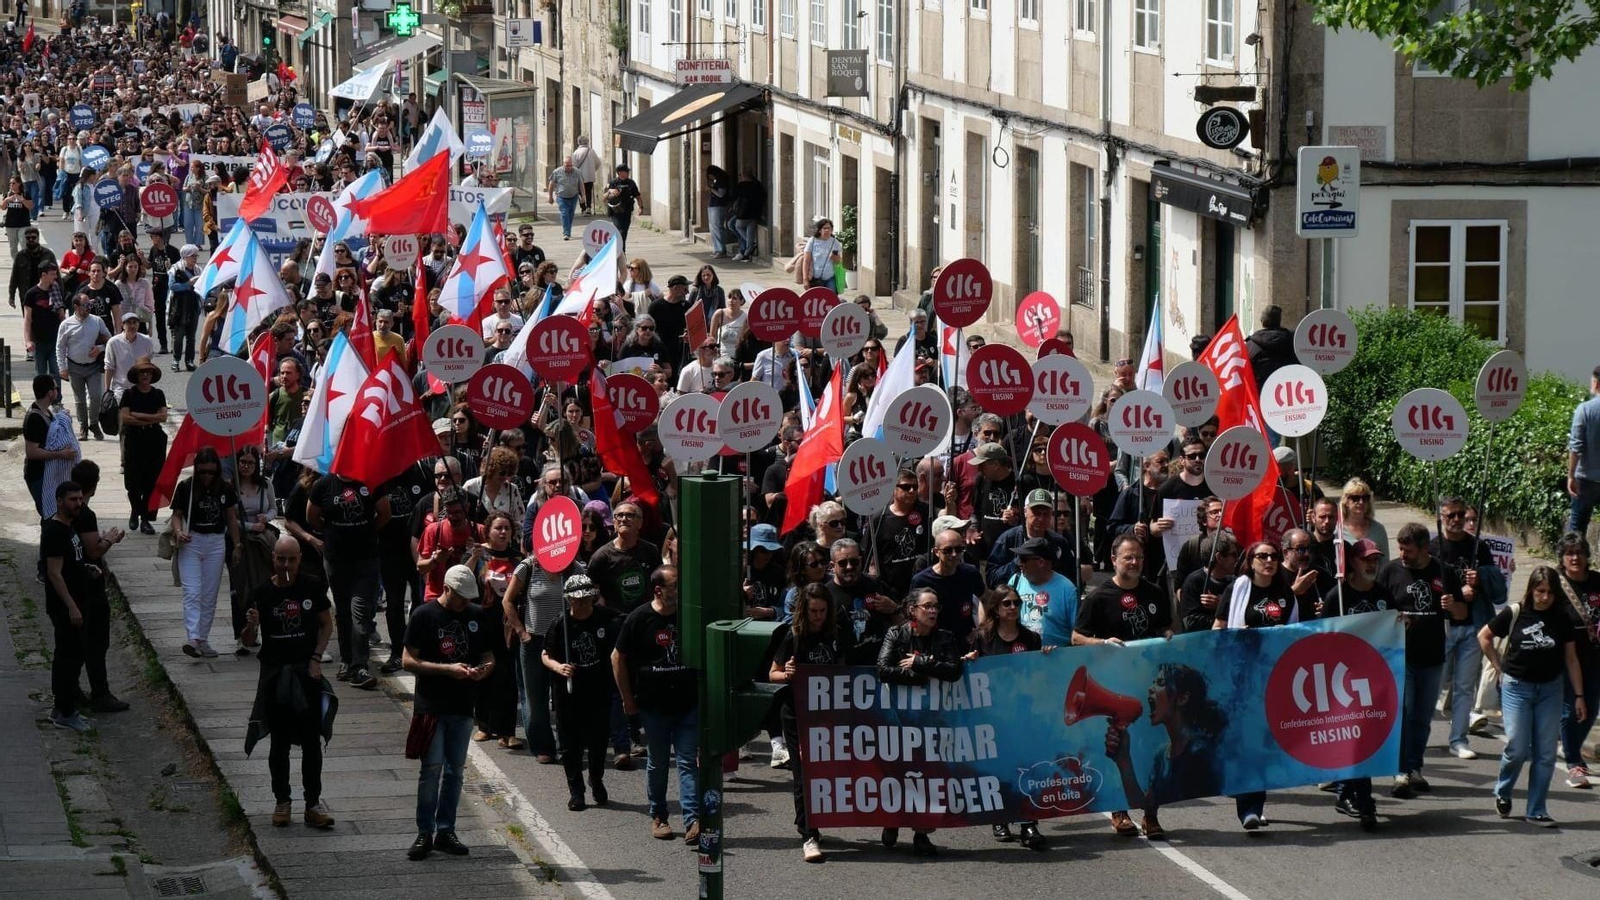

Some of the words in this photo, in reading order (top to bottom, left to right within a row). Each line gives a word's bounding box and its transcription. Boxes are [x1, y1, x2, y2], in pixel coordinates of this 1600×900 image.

[678, 61, 730, 71] CONFITERIA
[831, 56, 863, 64] DENTAL
[831, 70, 861, 78] ROQUE
[74, 118, 94, 126] STEG
[268, 136, 289, 146] STEG
[470, 144, 492, 152] STEG
[88, 156, 108, 168] STEG
[100, 193, 122, 206] STEG
[148, 190, 171, 203] CIG
[313, 202, 333, 224] CIG
[591, 228, 612, 244] CIG
[392, 239, 412, 254] CIG
[946, 274, 982, 299] CIG
[760, 299, 794, 320] CIG
[804, 297, 832, 318] CIG
[952, 306, 972, 314] ENSINO
[766, 324, 785, 332] ENSINO
[832, 315, 861, 336] CIG
[1308, 323, 1346, 348] CIG
[436, 338, 474, 359] CIG
[540, 330, 579, 353] CIG
[444, 364, 465, 372] ENSINO
[548, 360, 570, 368] ENSINO
[1211, 332, 1246, 391] CIG
[1314, 354, 1336, 362] ENSINO
[979, 359, 1022, 387] CIG
[1038, 370, 1080, 396] CIG
[1487, 366, 1518, 392] CIG
[202, 374, 252, 404] CIG
[482, 375, 523, 408] CIG
[992, 393, 1014, 401] ENSINO
[1174, 375, 1209, 400] CIG
[1274, 380, 1315, 408] CIG
[608, 386, 647, 411] CIG
[1046, 402, 1070, 411] ENSINO
[1490, 400, 1508, 408] ENSINO
[216, 410, 242, 420] ENSINO
[486, 406, 508, 418] ENSINO
[730, 396, 770, 424] CIG
[900, 400, 938, 432] CIG
[1122, 405, 1164, 429] CIG
[1182, 406, 1202, 415] ENSINO
[1284, 413, 1306, 422] ENSINO
[1408, 404, 1454, 431] CIG
[674, 408, 717, 435] CIG
[740, 428, 761, 439] ENSINO
[900, 434, 922, 444] ENSINO
[1420, 438, 1444, 446] ENSINO
[680, 440, 704, 449] ENSINO
[1060, 438, 1098, 468] CIG
[1220, 442, 1258, 470] CIG
[849, 454, 886, 486] CIG
[1069, 472, 1090, 482] ENSINO
[1222, 477, 1244, 486] ENSINO
[860, 488, 880, 501] ENSINO
[542, 511, 572, 544] CIG
[550, 546, 566, 558] ENSINO
[808, 671, 993, 712] RECTIFICAR
[1291, 660, 1374, 714] CIG
[1280, 714, 1324, 731] Confederación
[1324, 710, 1364, 727] Intersindical
[1365, 708, 1387, 723] Galega
[808, 724, 998, 763] RECUPERAR
[1310, 725, 1362, 747] ENSINO
[1027, 772, 1093, 792] Profesorado
[810, 770, 1004, 815] RECOÑECER
[1042, 794, 1056, 804] en
[1058, 789, 1082, 804] loita
